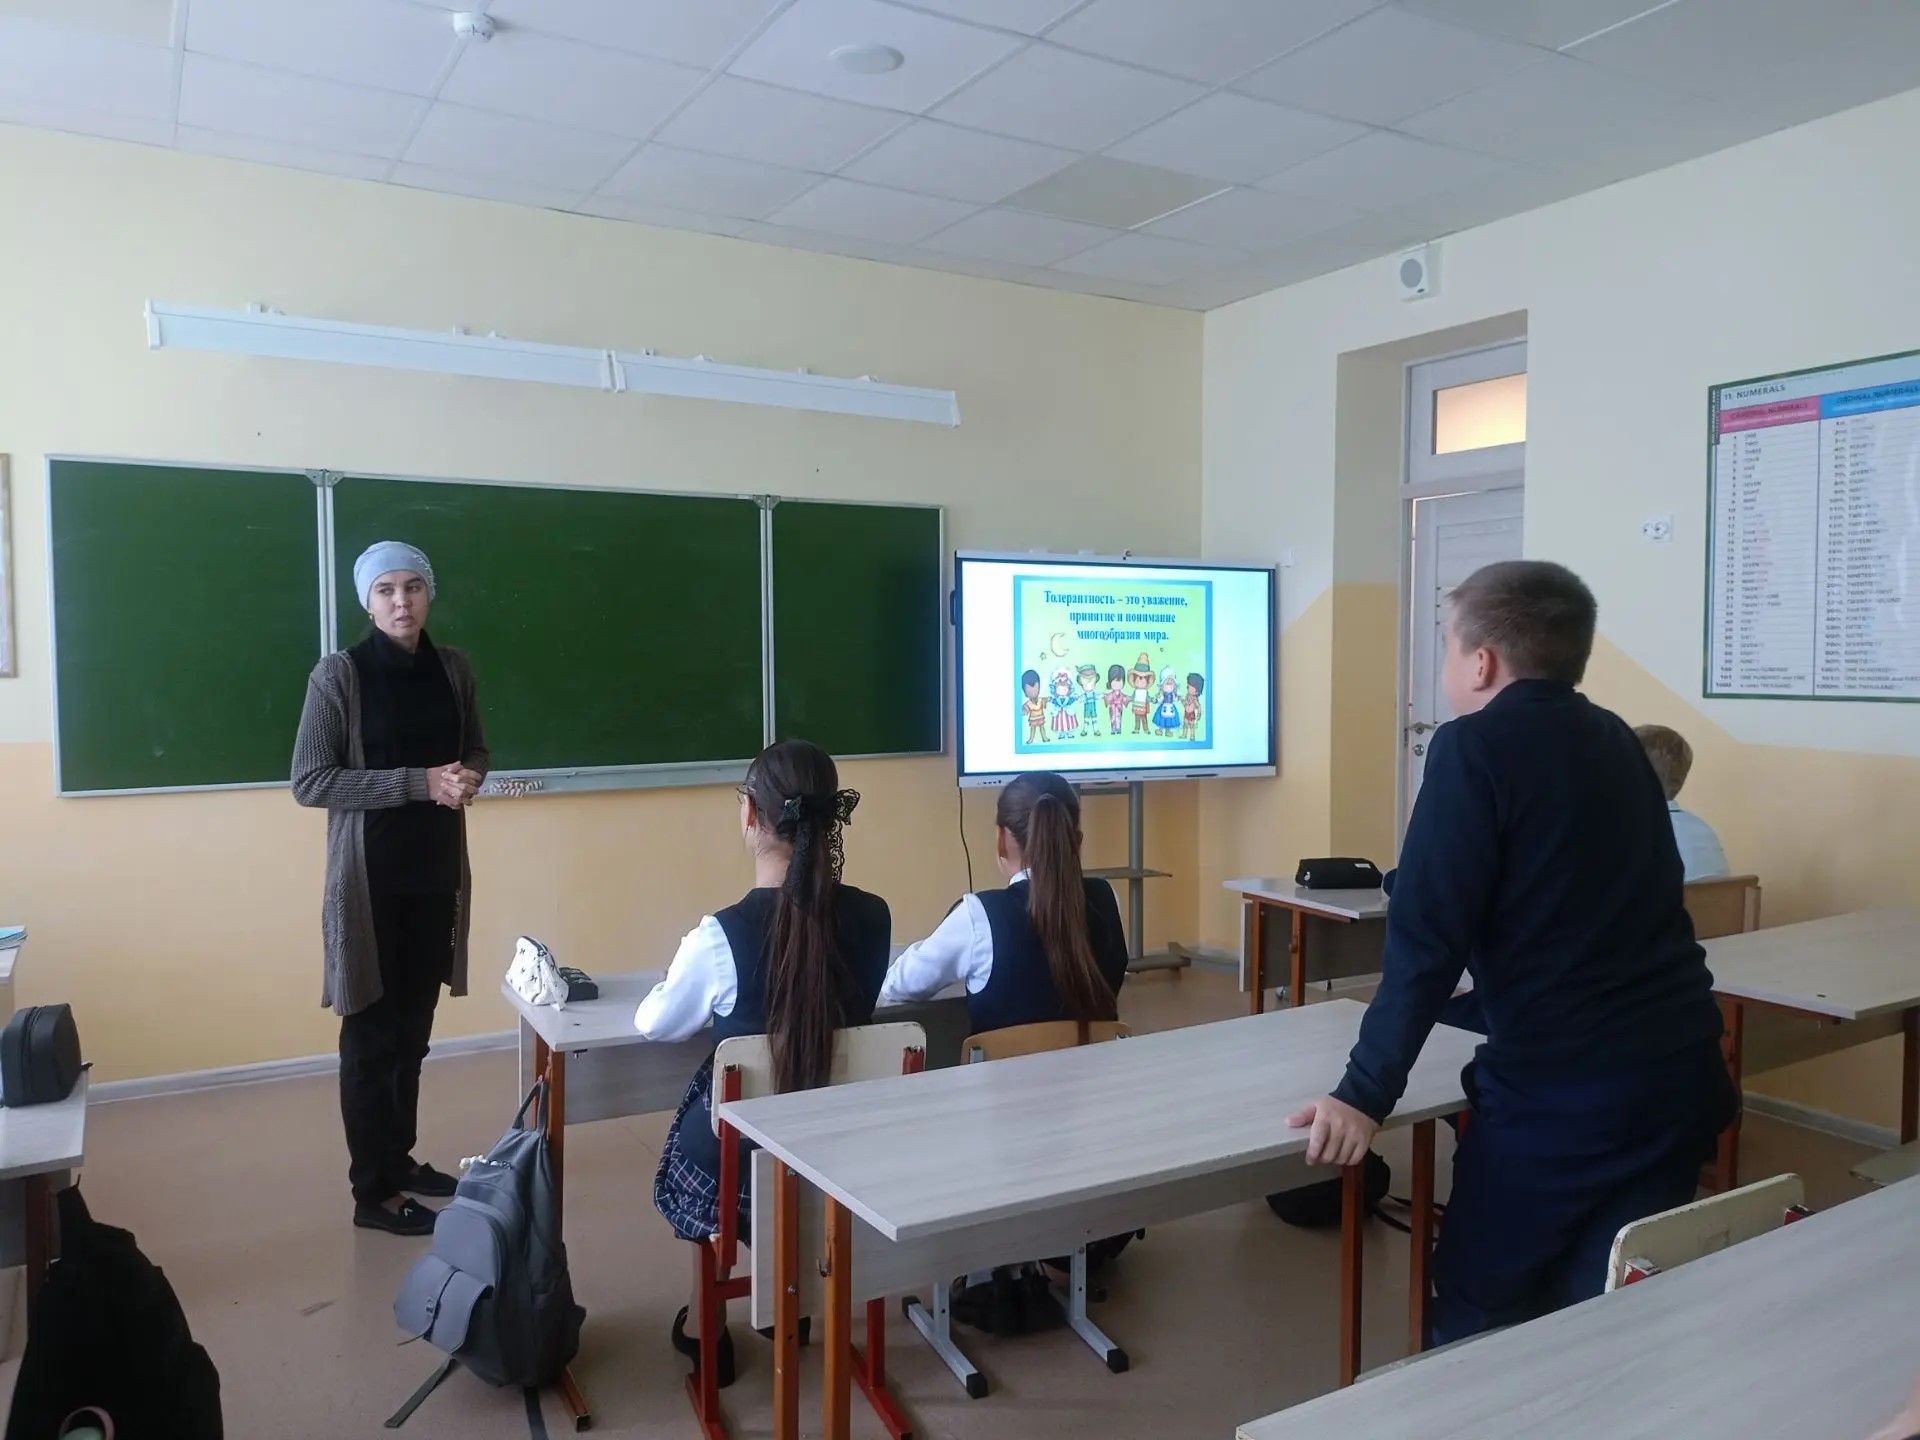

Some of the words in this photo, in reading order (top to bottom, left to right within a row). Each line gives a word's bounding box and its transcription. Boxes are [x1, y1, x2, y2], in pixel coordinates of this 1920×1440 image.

[1737, 384, 1786, 399] NUMERALS
[1044, 590, 1115, 605] Толерантность
[1125, 595, 1140, 605] это
[1142, 595, 1188, 608] уважение,
[1069, 611, 1115, 624] принятие
[1117, 612, 1123, 622] и
[1125, 612, 1176, 623] понимание
[1077, 628, 1140, 643] многообразия
[1143, 631, 1169, 644] мира.
